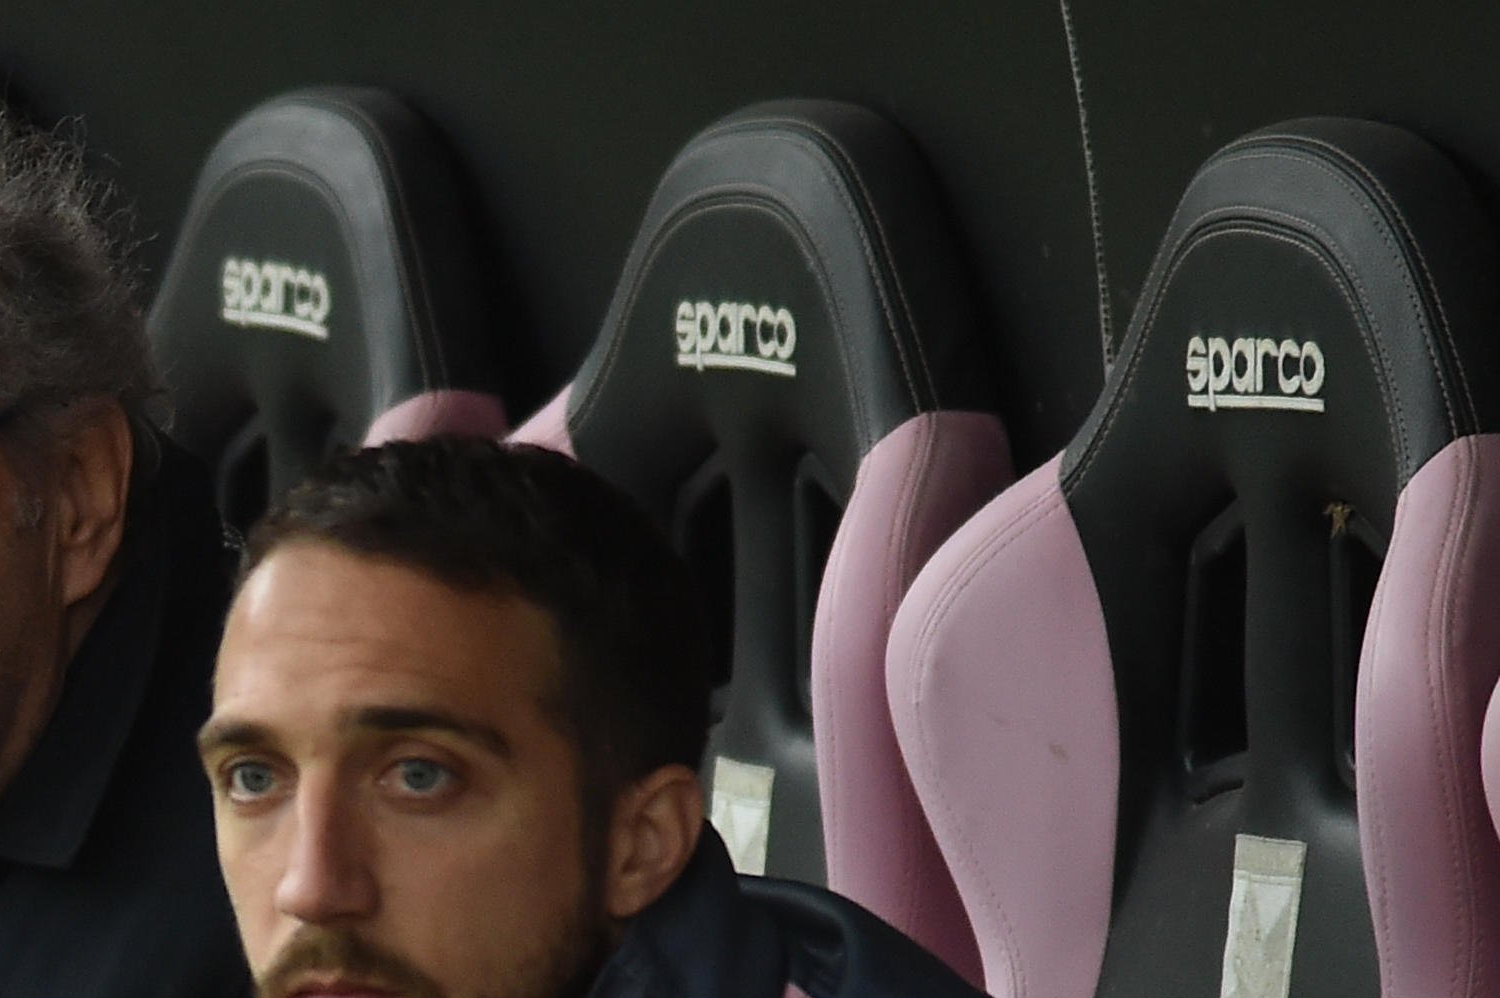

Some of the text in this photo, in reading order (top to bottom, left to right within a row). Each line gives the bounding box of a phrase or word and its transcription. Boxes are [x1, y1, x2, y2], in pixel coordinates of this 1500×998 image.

[220, 256, 332, 340] sparco
[674, 299, 798, 378] sparco
[1185, 335, 1325, 413] sparco
